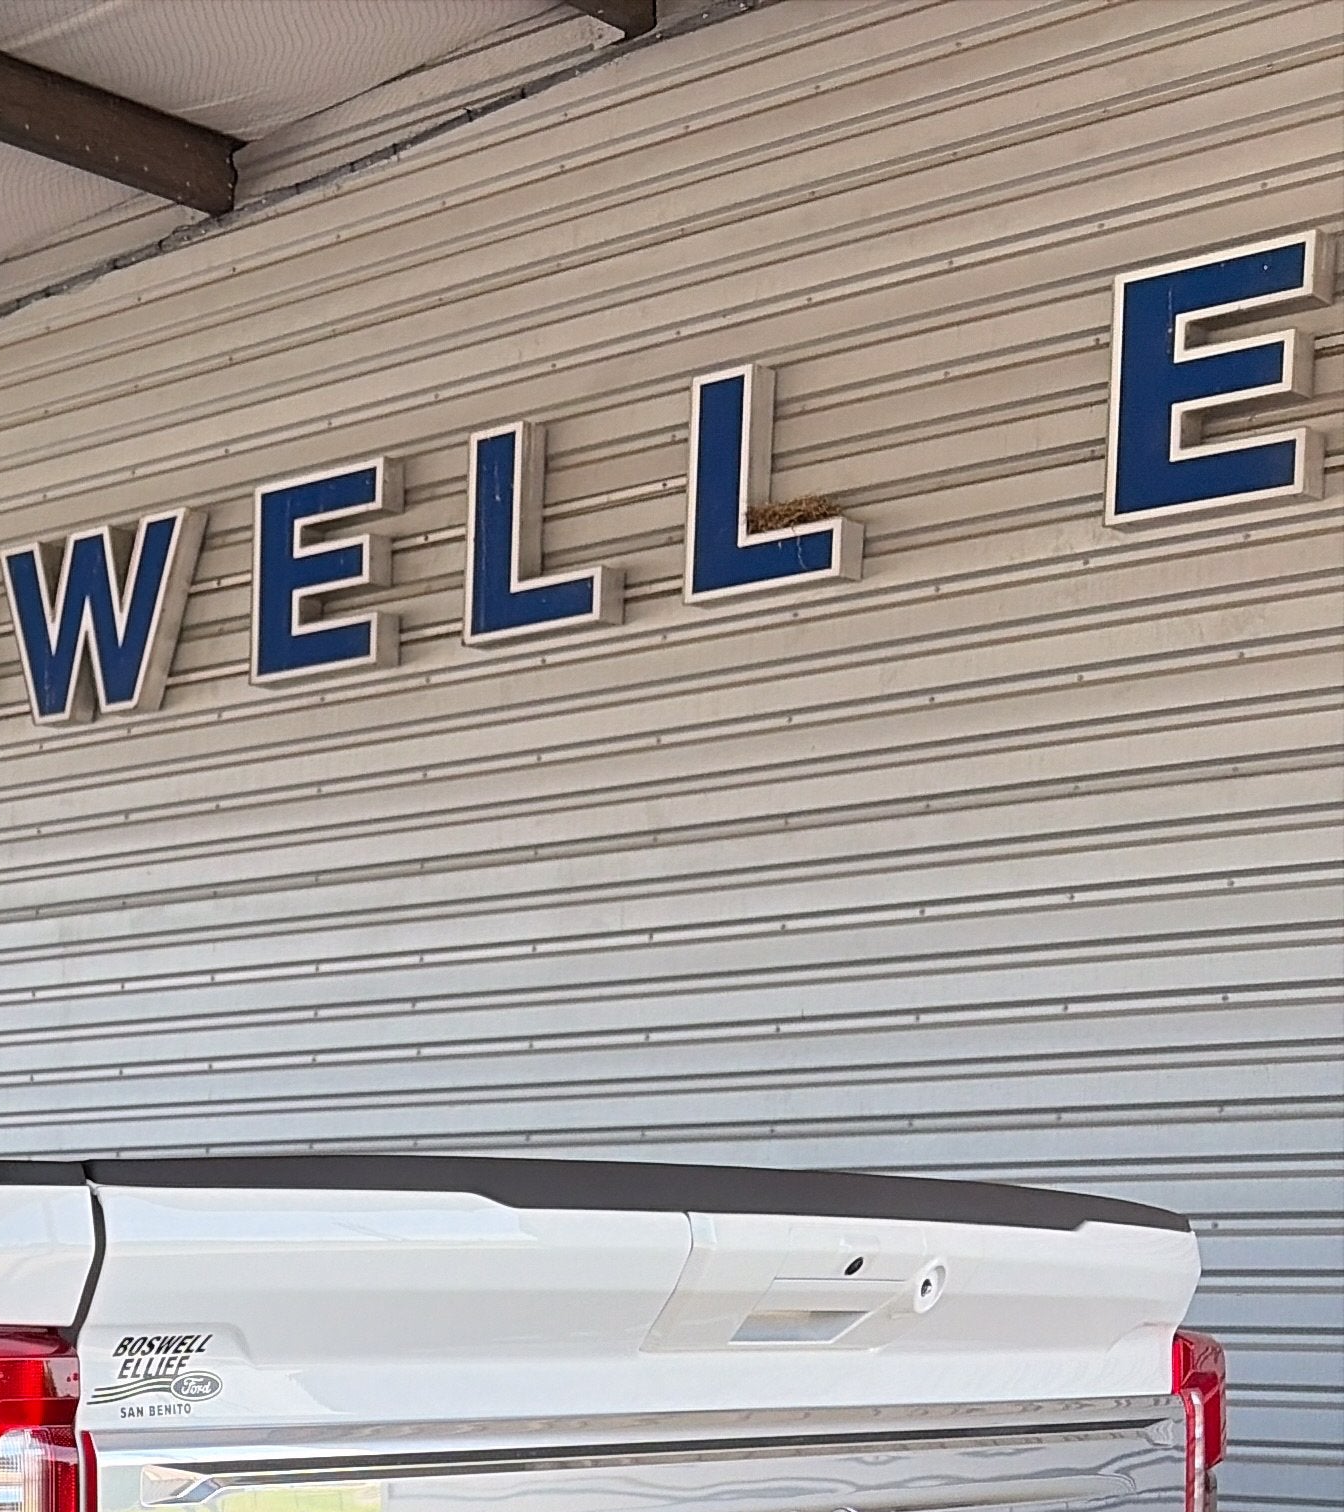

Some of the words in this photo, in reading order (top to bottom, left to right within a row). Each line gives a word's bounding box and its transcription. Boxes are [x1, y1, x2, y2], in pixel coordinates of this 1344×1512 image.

[1104, 229, 1324, 527] E
[112, 1333, 214, 1358] BOSWELL
[120, 1406, 144, 1419] SAN
[148, 1403, 192, 1418] BENITO
